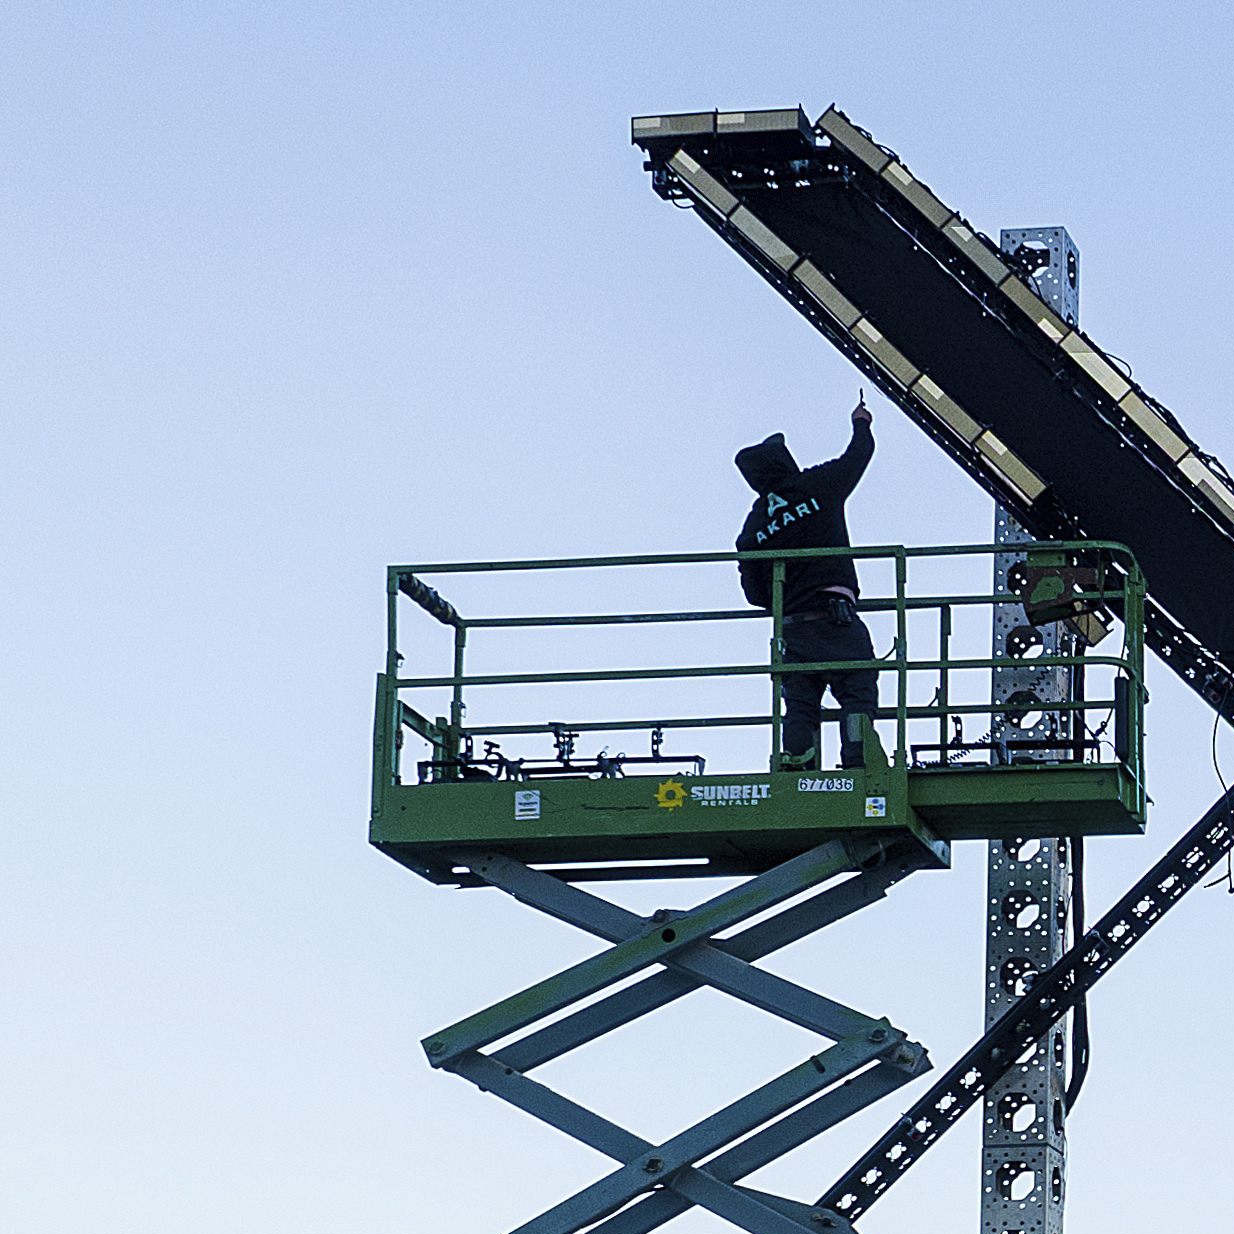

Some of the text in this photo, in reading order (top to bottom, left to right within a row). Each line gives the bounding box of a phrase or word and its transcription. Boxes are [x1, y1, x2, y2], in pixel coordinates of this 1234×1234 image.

[756, 498, 820, 544] AKARI
[690, 784, 770, 800] SUNBELT
[799, 778, 853, 791] 677036
